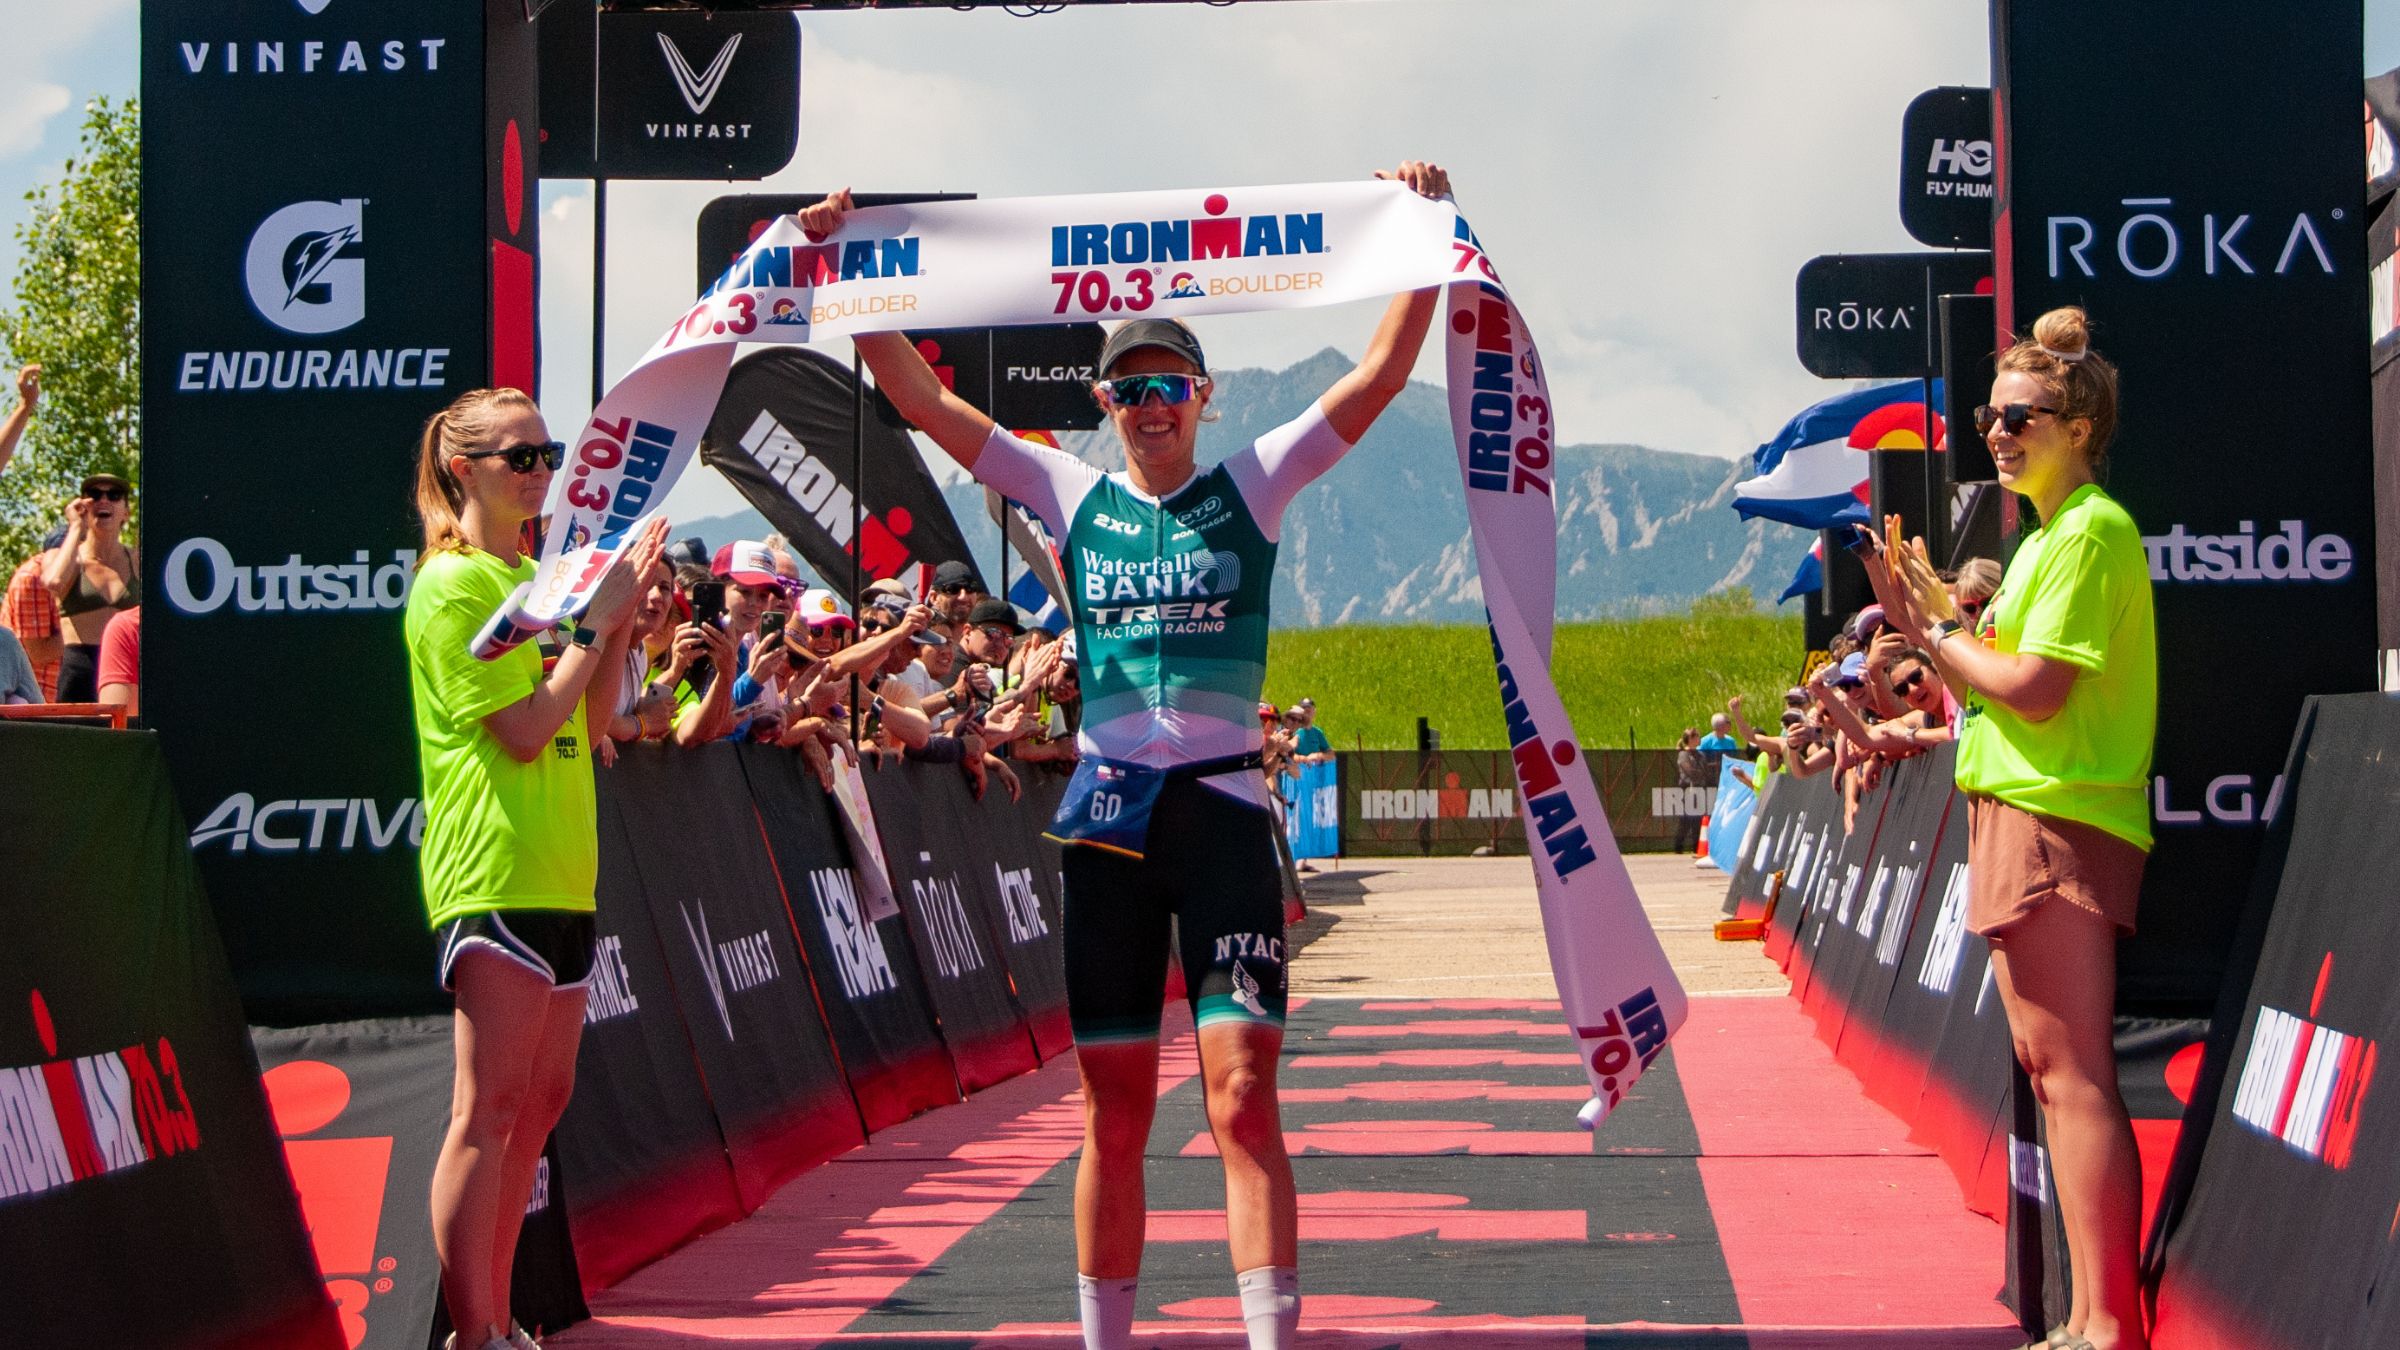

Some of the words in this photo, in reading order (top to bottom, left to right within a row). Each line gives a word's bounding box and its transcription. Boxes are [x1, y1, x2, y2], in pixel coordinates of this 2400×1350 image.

[181, 39, 445, 73] VINFAST
[646, 124, 752, 139] VINFAST
[1927, 138, 1992, 177] HO
[1926, 181, 1953, 195] FLY
[1955, 183, 1992, 198] HUM
[1051, 194, 1323, 267] IRONMAN
[1051, 268, 1155, 314] 70.3
[1209, 272, 1324, 296] BOULDER
[812, 294, 918, 325] BOULDER
[179, 348, 450, 391] ENDURANCE
[1007, 366, 1093, 381] FULGAZ
[1513, 394, 1550, 497] 70.3
[567, 416, 632, 512] 70.3
[1093, 513, 1142, 535] 2XU
[1171, 511, 1233, 541] BONTRAGER
[165, 537, 417, 613] Outsid
[1082, 546, 1191, 576] Waterfall
[1085, 569, 1210, 601] BANK
[1088, 599, 1231, 625] TREK
[1097, 623, 1161, 640] FACTORY
[1164, 620, 1226, 634] RACING
[1361, 772, 1513, 819] IRONMAN
[719, 929, 780, 992] VINFAST
[1215, 932, 1281, 963] NYAC
